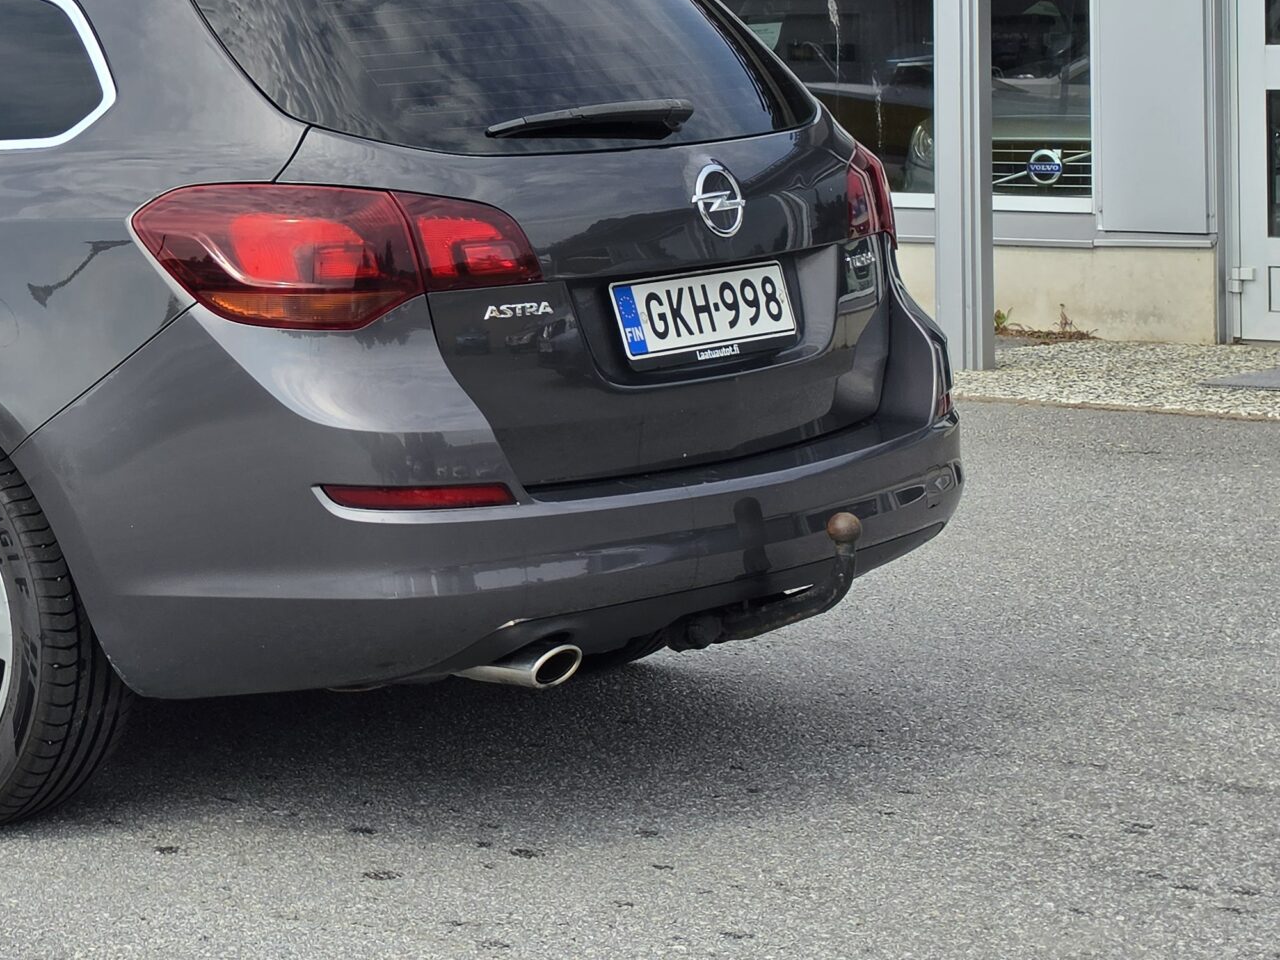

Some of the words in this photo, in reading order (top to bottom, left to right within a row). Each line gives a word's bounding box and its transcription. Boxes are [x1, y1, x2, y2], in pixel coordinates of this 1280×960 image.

[1029, 164, 1060, 172] VOLVO
[484, 301, 554, 320] ASTRA
[645, 275, 783, 340] GKH-998
[625, 326, 644, 343] FIN
